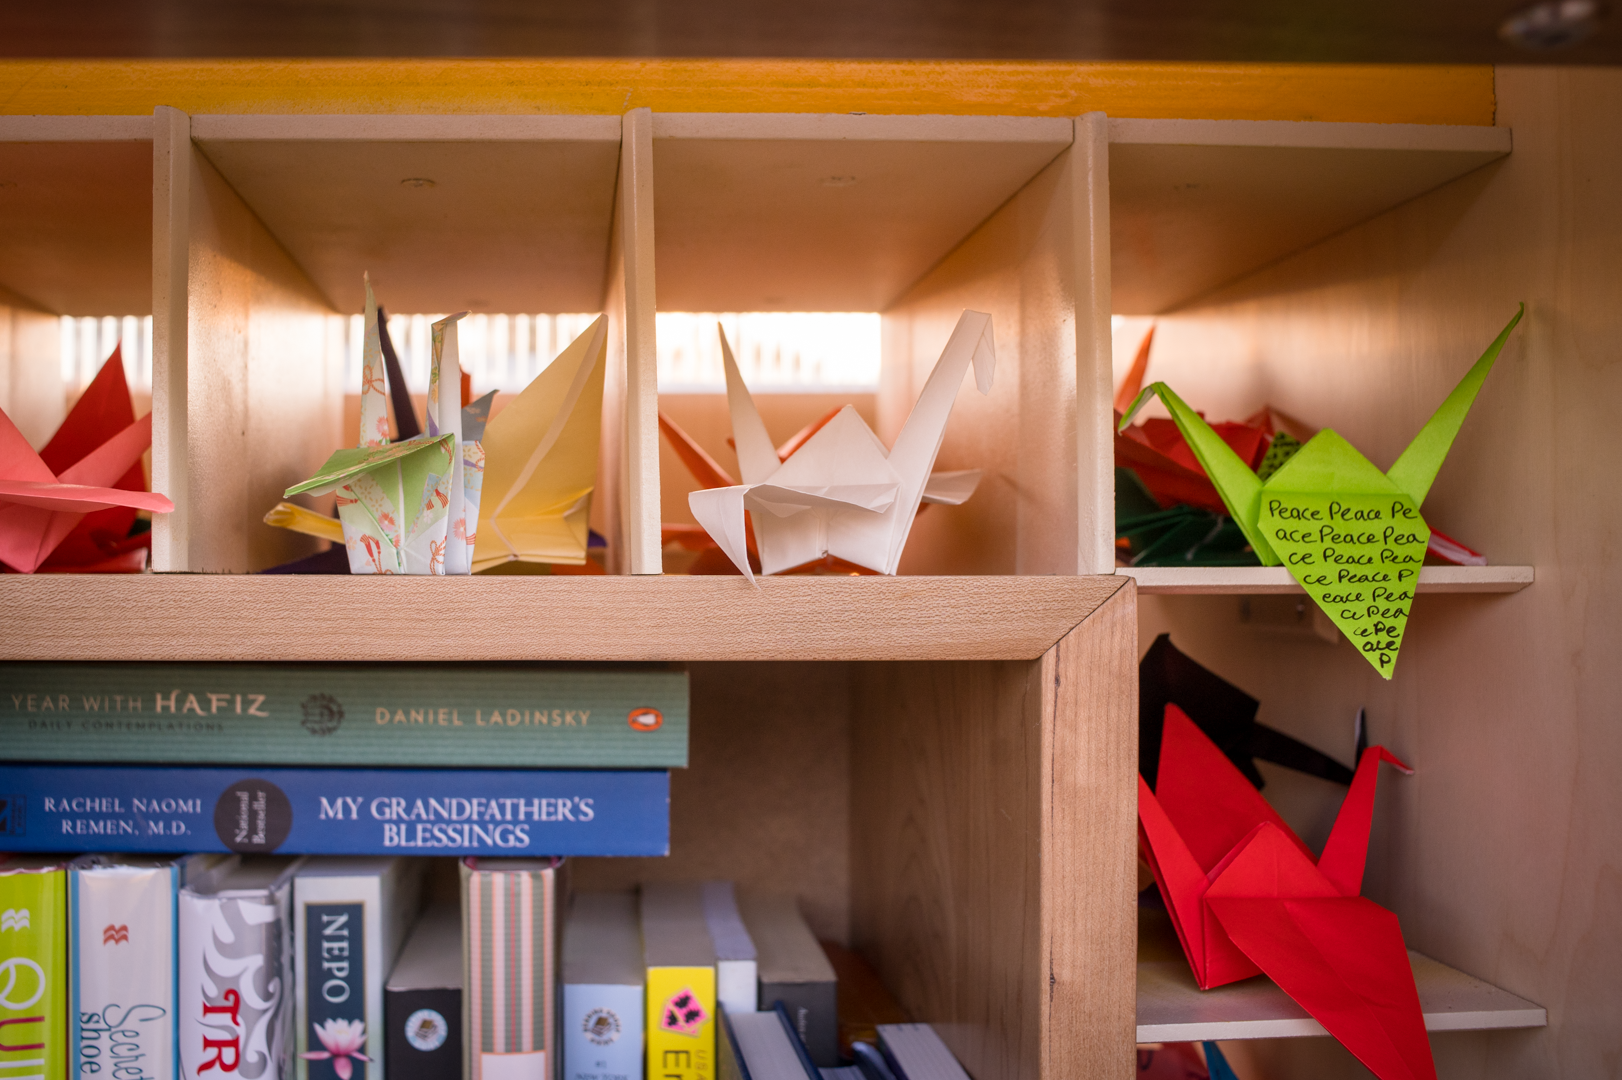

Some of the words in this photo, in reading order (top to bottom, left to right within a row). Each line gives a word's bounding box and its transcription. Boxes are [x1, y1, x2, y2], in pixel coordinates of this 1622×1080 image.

[1269, 500, 1323, 521] Peace
[1329, 501, 1382, 521] Peace
[1391, 501, 1418, 519] Pe
[1275, 528, 1317, 544] ace
[1319, 525, 1380, 545] Peace
[1383, 526, 1425, 545] Pea
[1288, 551, 1315, 565] ce
[1323, 547, 1374, 565] Peace
[1380, 548, 1421, 565] Pea
[1303, 573, 1333, 586] ce
[1338, 568, 1391, 584] Peace
[1398, 568, 1414, 583] P
[1322, 591, 1365, 604] eace
[1372, 586, 1414, 602] Pea
[1367, 605, 1409, 619] Pea
[1379, 652, 1392, 669] P
[11, 694, 70, 713] YEAR
[82, 694, 142, 714] WITH
[155, 689, 269, 718] HAFIZ
[375, 707, 463, 726] DANIEL
[476, 709, 591, 727] LADINSKY
[44, 796, 125, 813] RACHEL
[132, 798, 202, 814] NAOMI
[318, 796, 363, 820] MY
[370, 796, 595, 821] GRANDFATHER'S
[61, 819, 139, 836] REMEN,
[148, 820, 191, 836] M.D.
[383, 824, 531, 848] BLESSINGS
[322, 913, 350, 1004] NEPO
[80, 1012, 102, 1075] shoe
